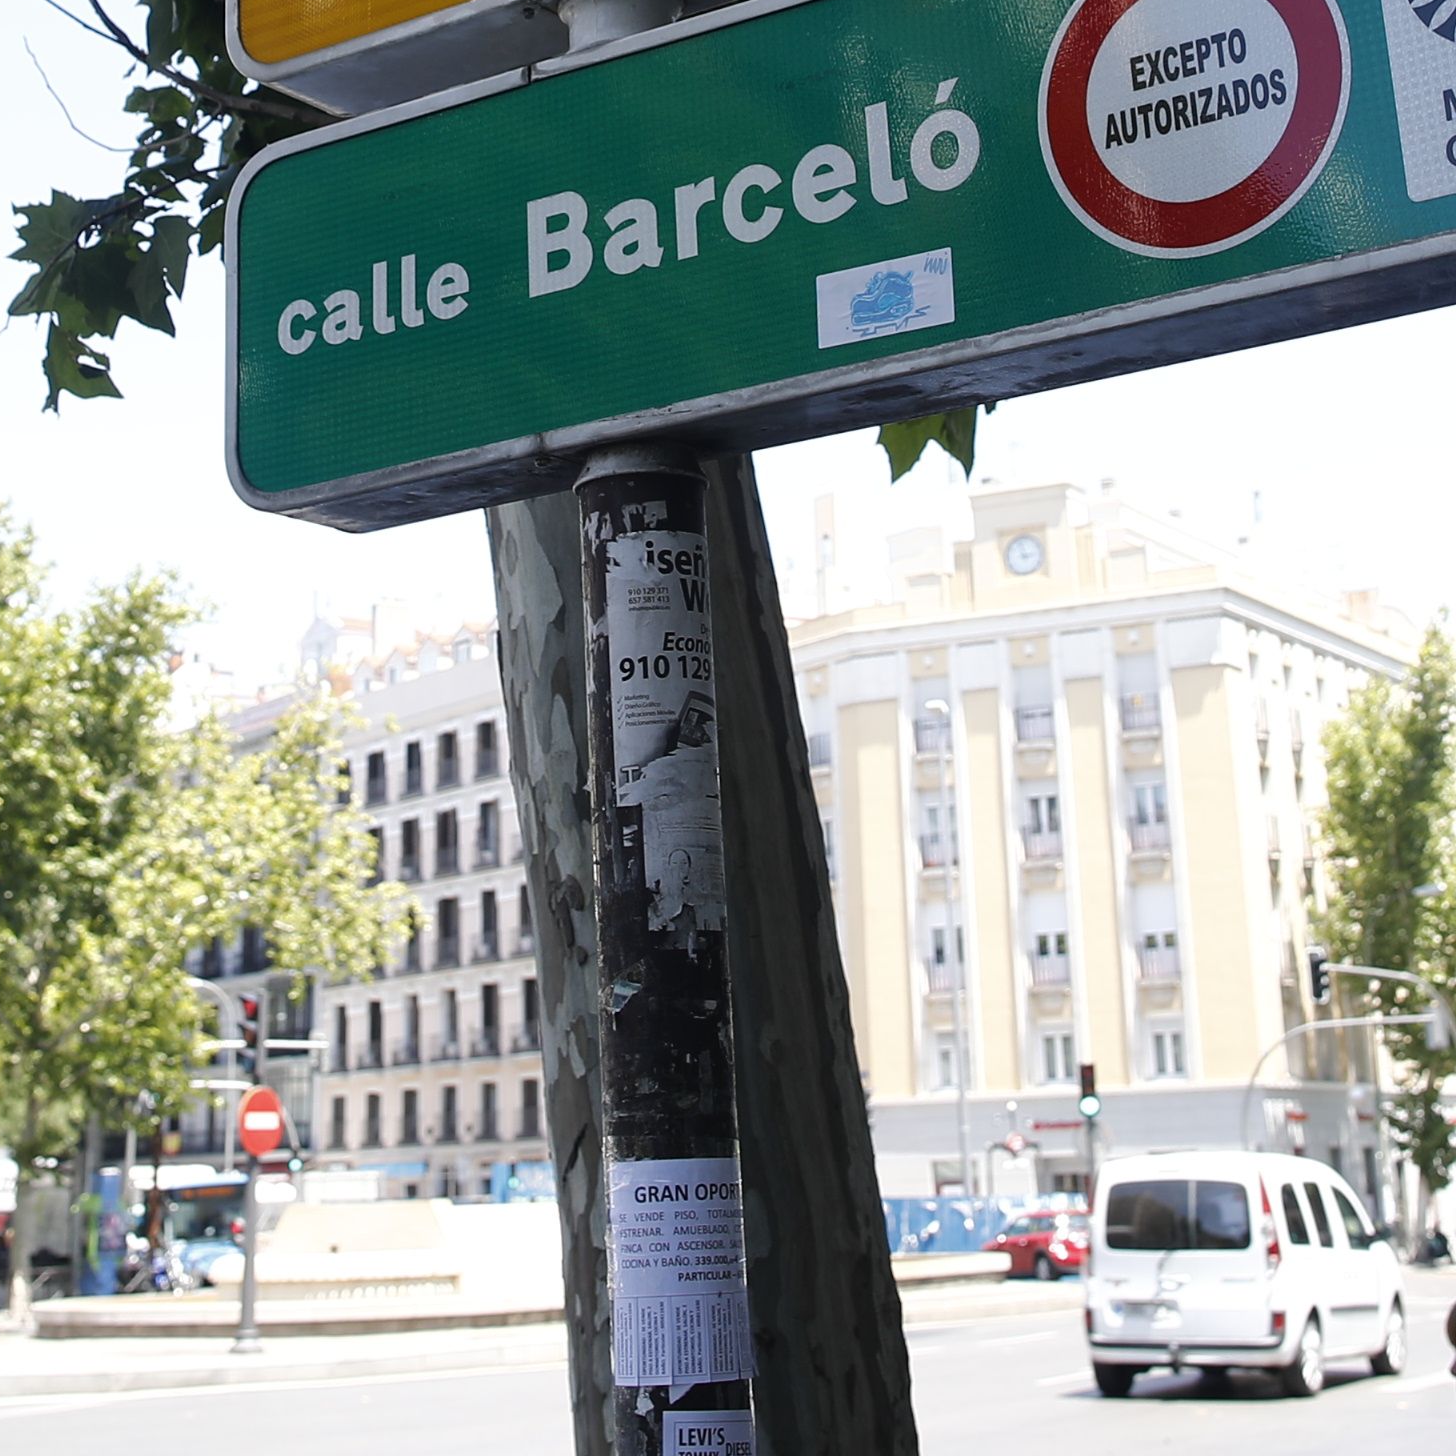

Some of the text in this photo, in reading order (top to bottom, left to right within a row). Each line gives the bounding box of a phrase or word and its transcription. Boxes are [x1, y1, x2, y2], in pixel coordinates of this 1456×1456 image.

[1129, 28, 1246, 91] EXCEPTO
[1105, 68, 1288, 150] AUTORIZADOS
[277, 77, 981, 355] calle Barceló
[619, 655, 712, 682] 910 129
[634, 1184, 689, 1204] GRAN
[634, 1211, 665, 1222] VENDE
[648, 1242, 670, 1253] CON
[654, 1258, 660, 1267] Y
[679, 1428, 725, 1446] LEVI'S
